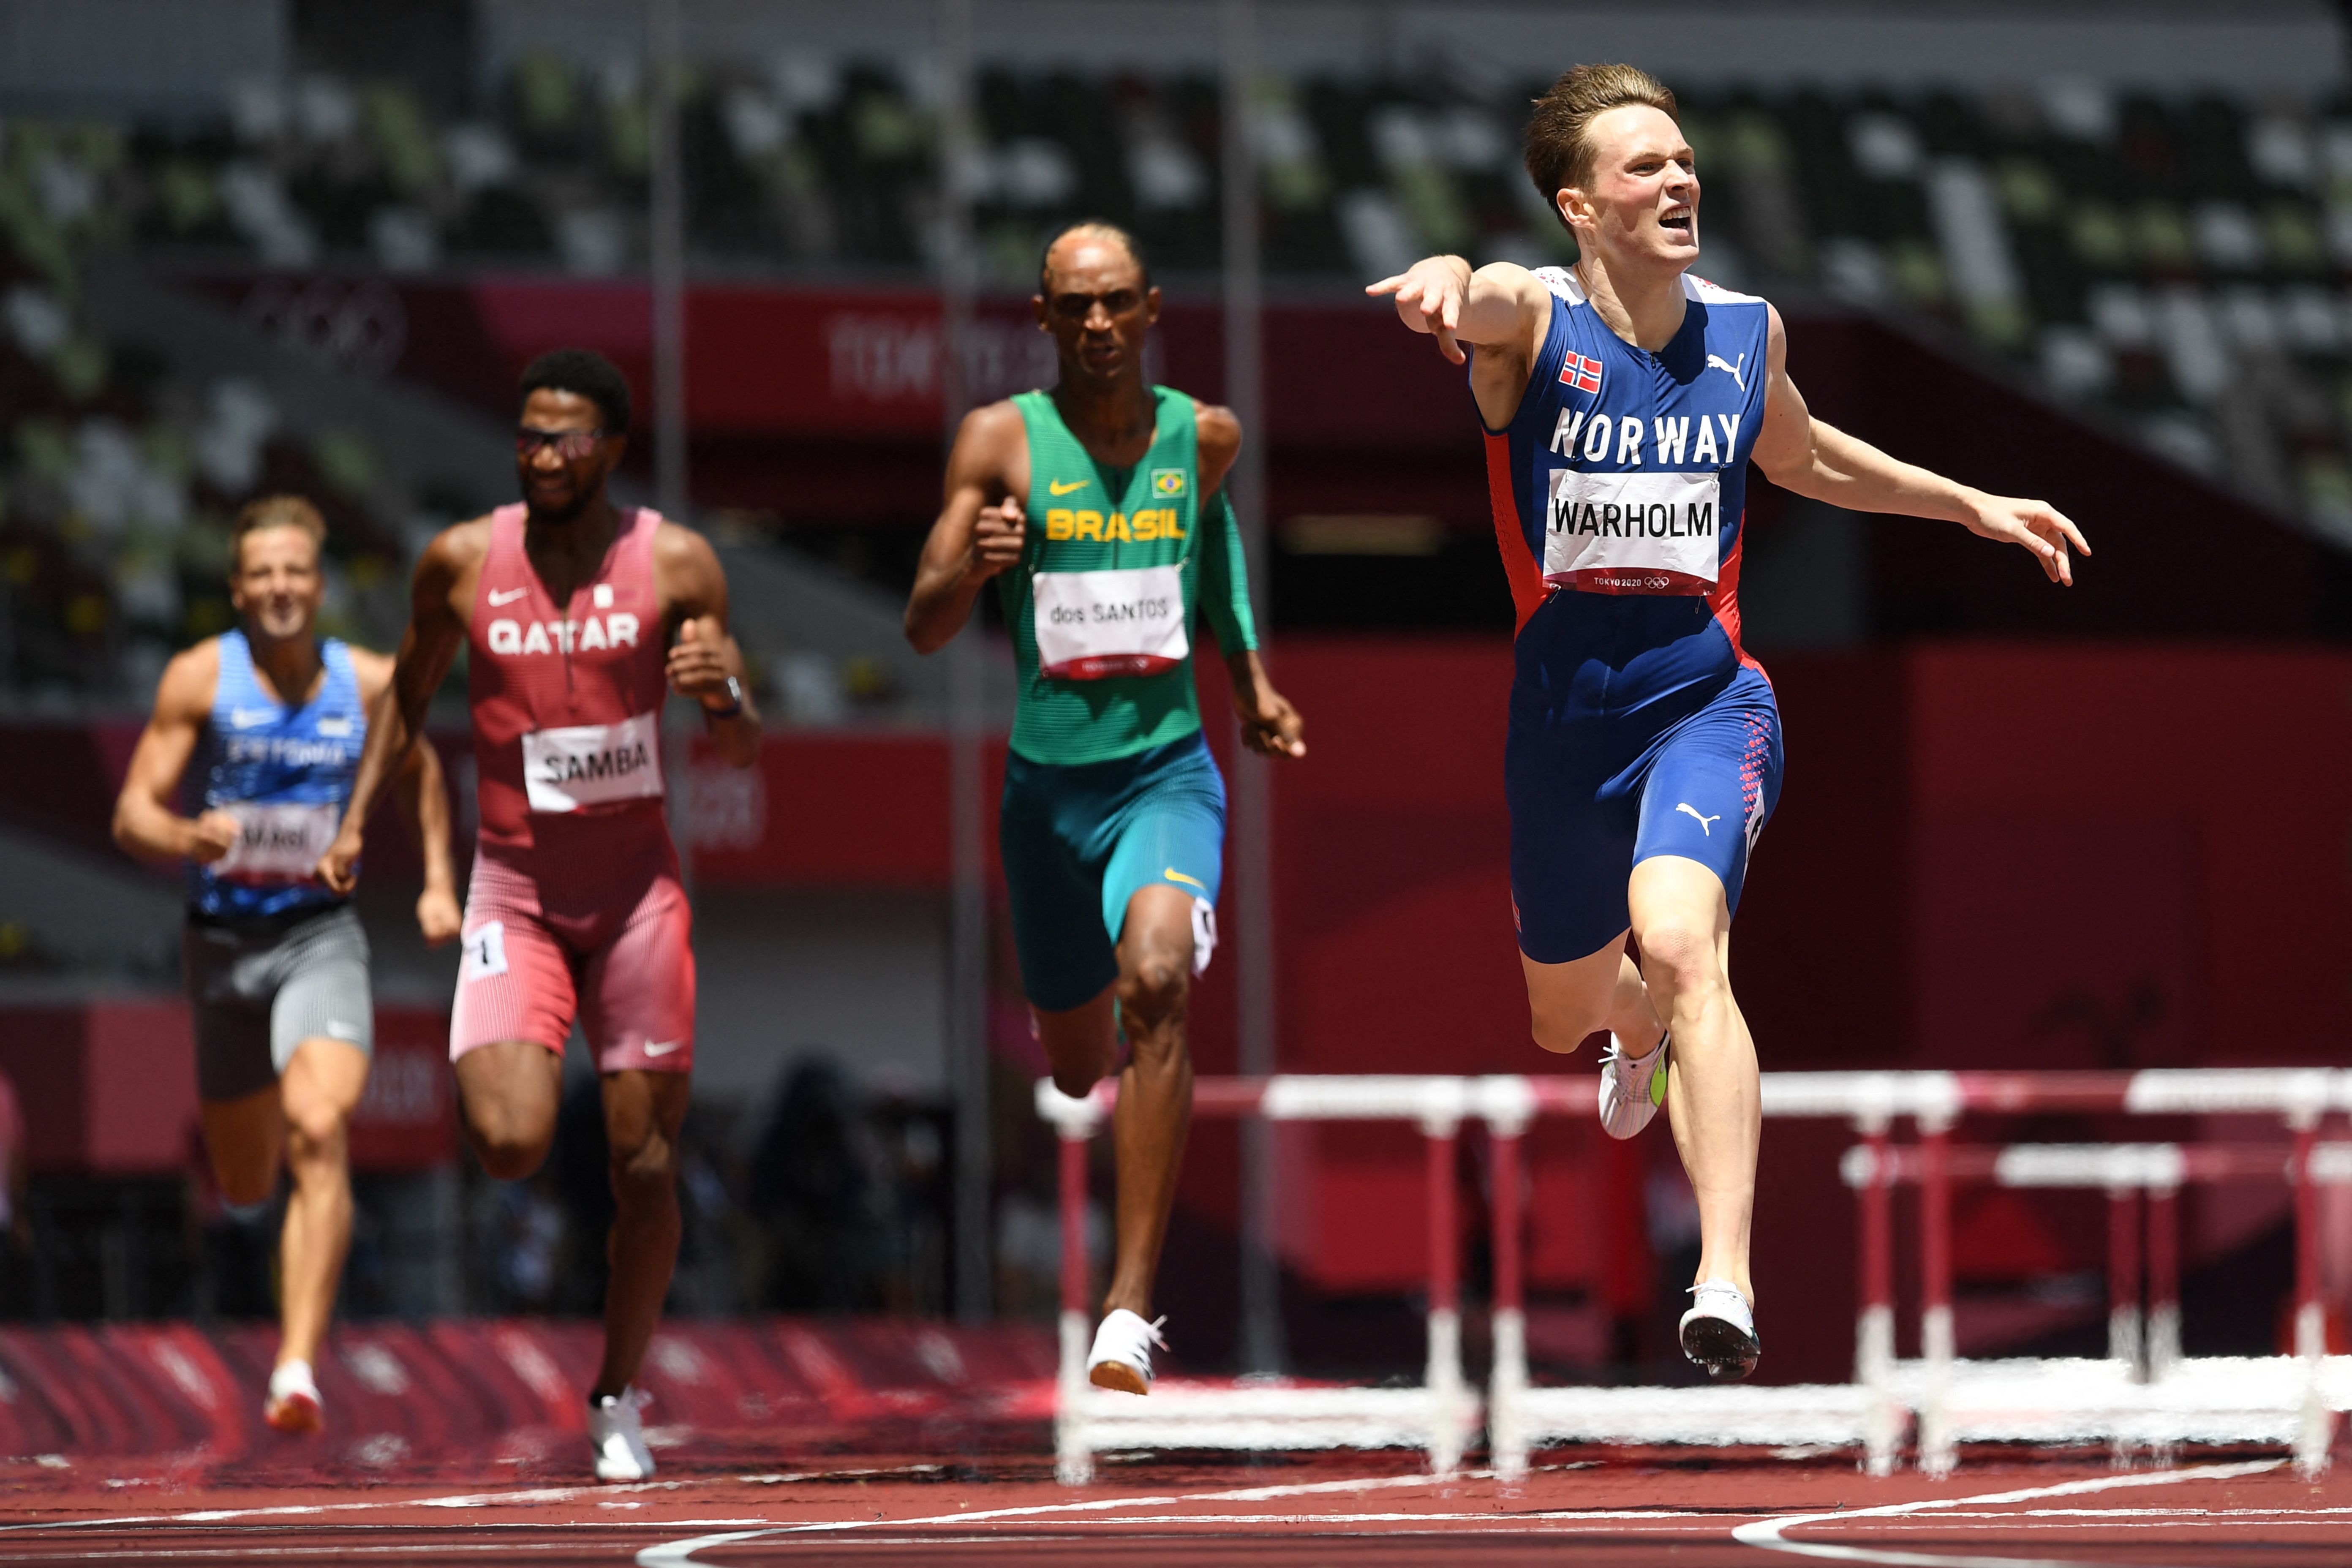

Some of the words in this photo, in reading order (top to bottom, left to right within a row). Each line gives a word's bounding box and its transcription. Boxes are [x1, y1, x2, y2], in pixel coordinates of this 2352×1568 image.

[1549, 407, 1740, 464] NORWAY
[1046, 509, 1186, 542] BRASIL
[1555, 498, 1712, 537] WARHOLM
[1594, 577, 1620, 586] TOKYO
[1051, 604, 1084, 624] dos
[1092, 599, 1168, 622] SANTOS
[488, 613, 640, 655] QATAR
[545, 740, 648, 784] SAMBA
